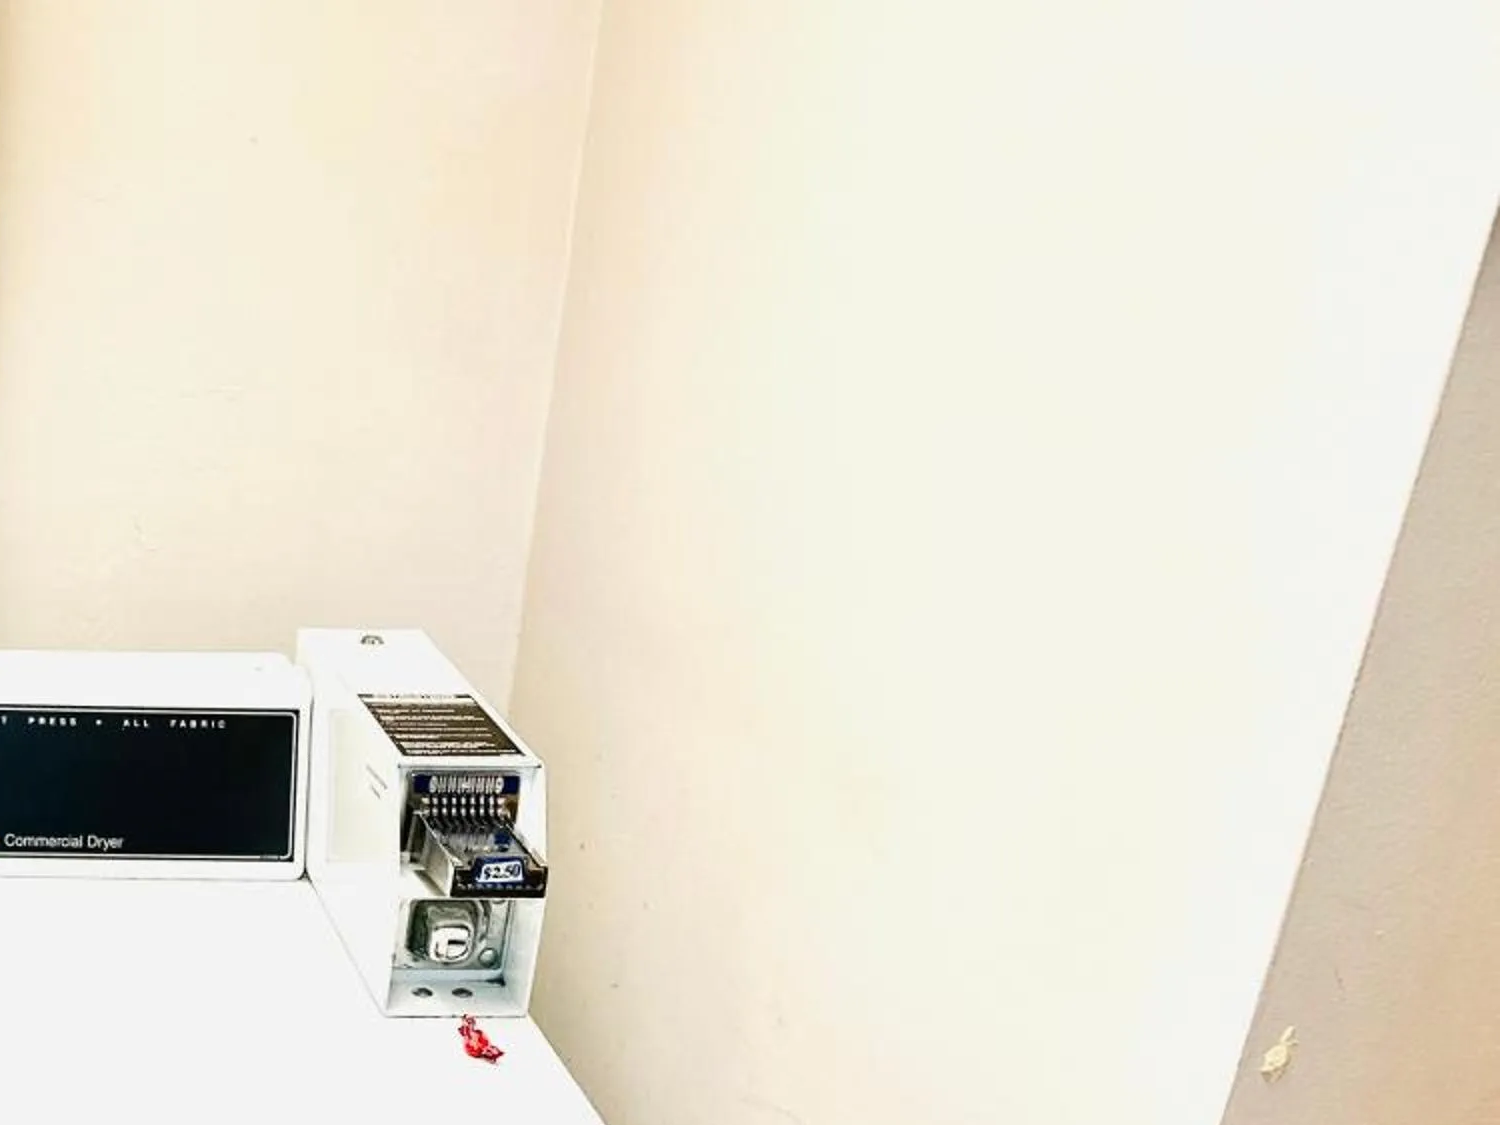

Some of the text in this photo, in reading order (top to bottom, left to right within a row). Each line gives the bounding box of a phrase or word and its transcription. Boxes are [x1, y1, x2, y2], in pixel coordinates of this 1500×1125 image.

[28, 716, 79, 727] PRESS
[123, 718, 151, 728] ALL
[169, 719, 228, 729] FABRIC
[3, 832, 125, 851] Commercial Dryer
[483, 863, 521, 880] $2.50
